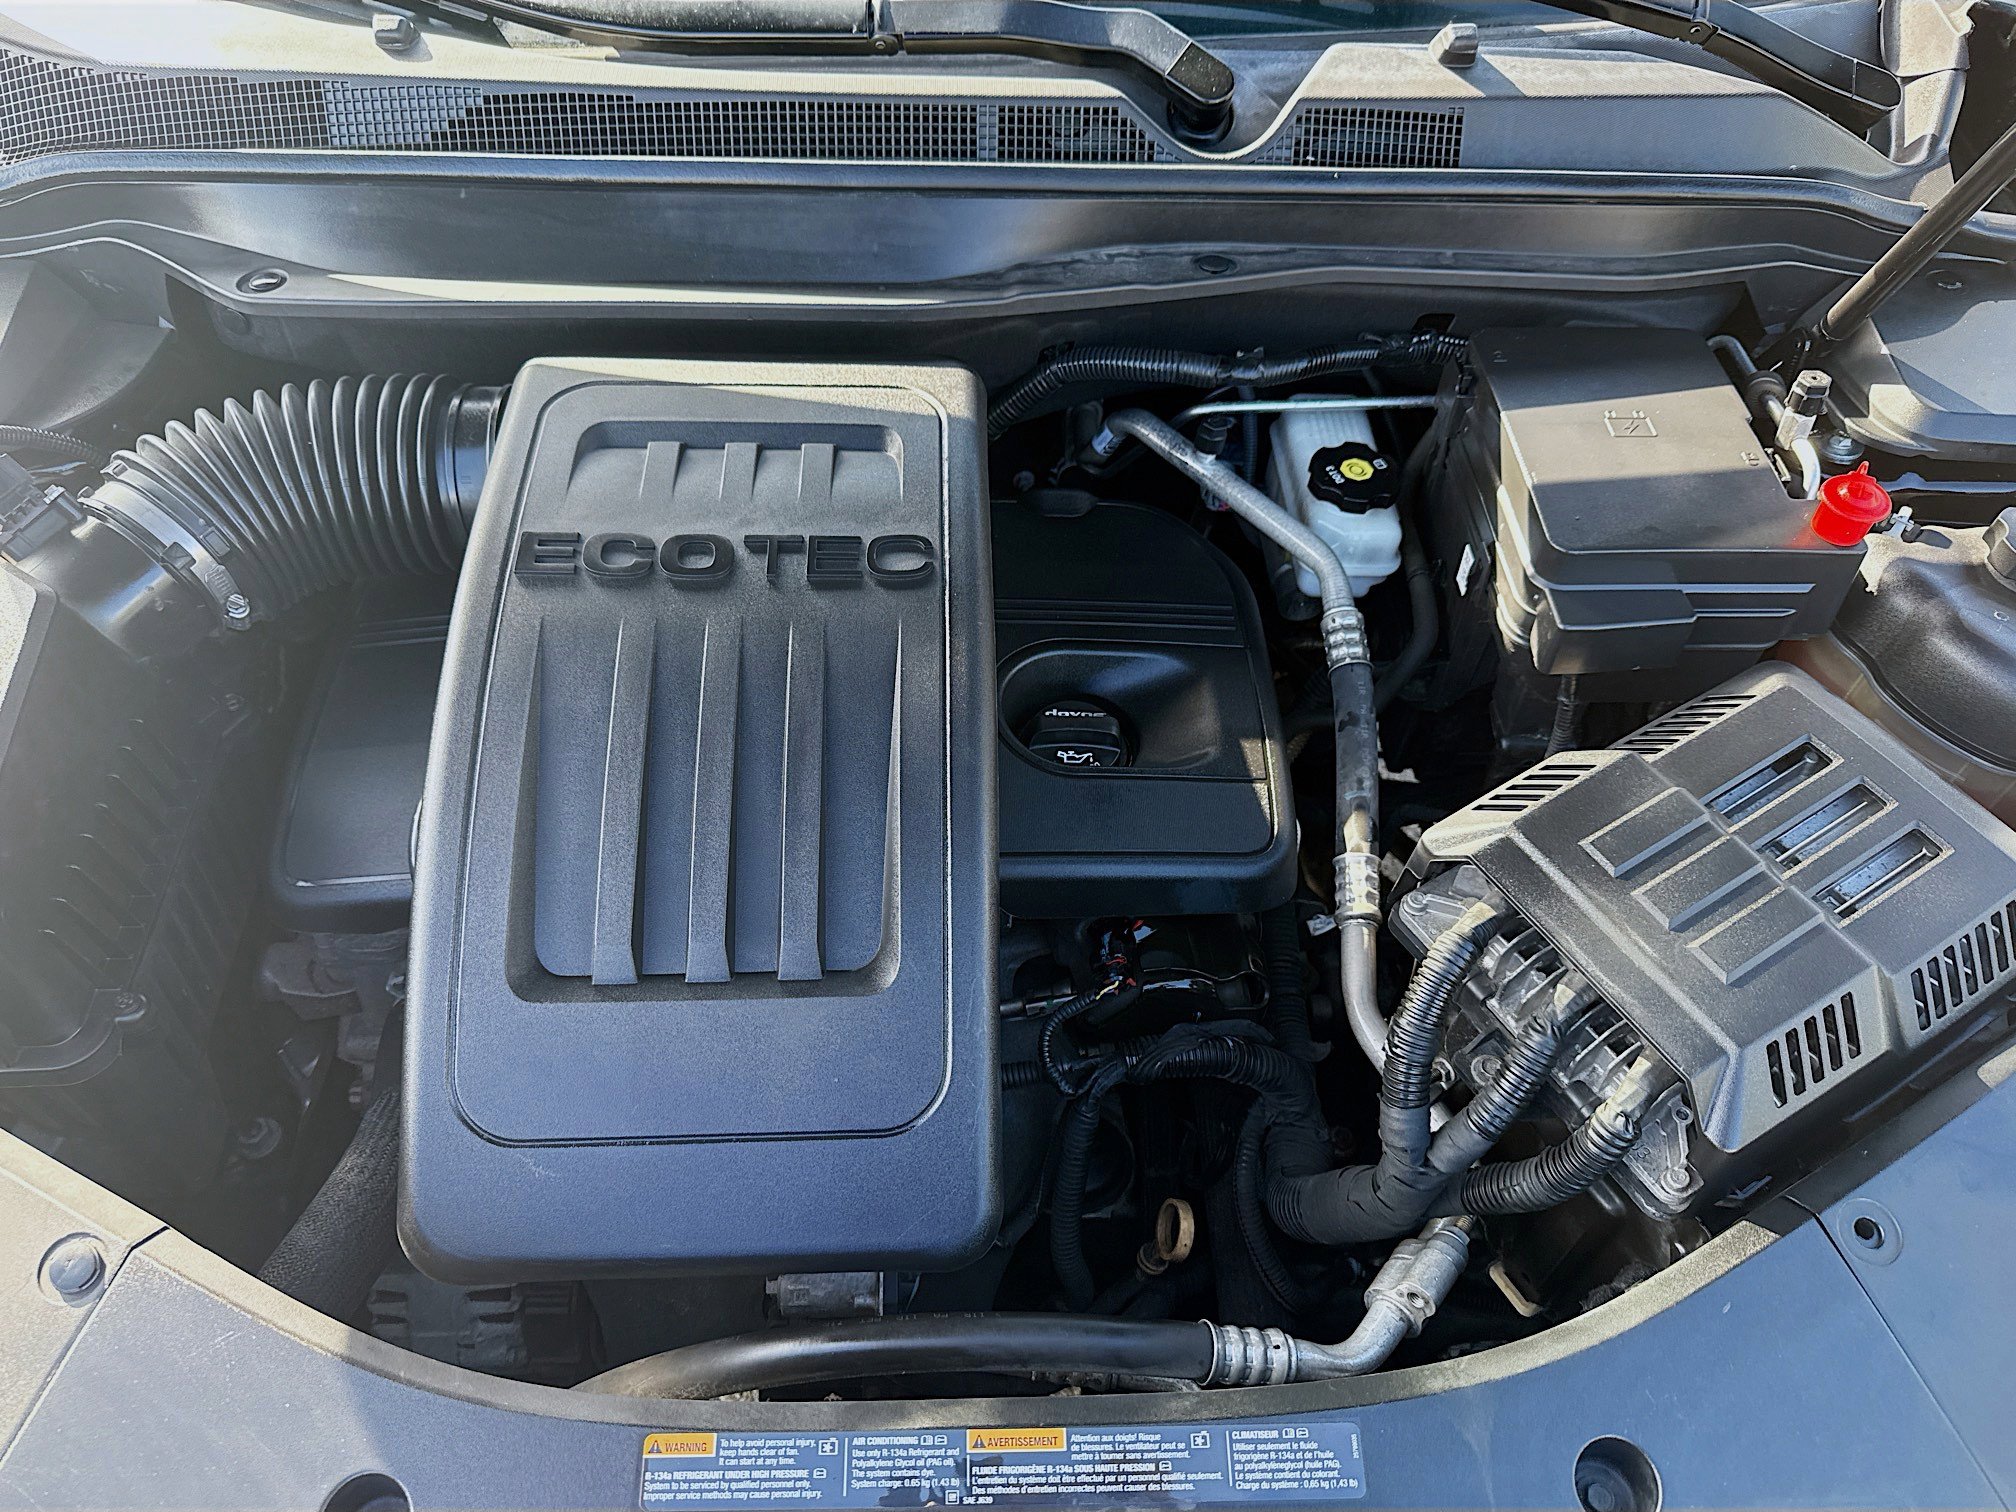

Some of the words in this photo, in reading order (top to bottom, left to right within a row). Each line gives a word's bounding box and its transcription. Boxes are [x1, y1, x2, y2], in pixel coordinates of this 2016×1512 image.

[514, 531, 935, 580] ECOTEC
[1071, 1434, 1100, 1442] Attention
[1139, 1433, 1161, 1441] Risque
[1232, 1430, 1279, 1439] CLIMATISEUR
[720, 1439, 729, 1447] To
[730, 1439, 744, 1448] help
[747, 1439, 764, 1447] avoid
[766, 1439, 794, 1448] personal
[867, 1437, 918, 1445] CONDITIONING
[988, 1436, 1058, 1447] AVERTISSEMENT
[1162, 1442, 1176, 1450] peut
[1233, 1442, 1255, 1450] Utiliser
[1257, 1442, 1290, 1450] seulement
[1300, 1441, 1318, 1449] fluide
[666, 1443, 706, 1452] WARNING
[867, 1449, 880, 1458] only
[909, 1448, 945, 1457] Refrigerant
[1233, 1452, 1268, 1462] frigorigène
[1270, 1451, 1294, 1460] R-134a
[852, 1459, 893, 1468] Polyalkylene
[895, 1458, 915, 1467] Glycol
[916, 1458, 924, 1466] oil
[926, 1458, 942, 1466] (PAG
[943, 1458, 956, 1466] oil).
[1305, 1460, 1322, 1470] (huile
[1324, 1460, 1341, 1469] PAG).
[866, 1470, 890, 1478] system
[921, 1469, 935, 1477] dye.
[972, 1466, 998, 1474] FLUIDE
[999, 1464, 1046, 1474] FRIGORIGÈNE
[1047, 1465, 1073, 1473] R-134a
[1096, 1464, 1118, 1472] HAUTE
[1120, 1463, 1155, 1472] PRESSION
[645, 1472, 672, 1480] R-134a
[673, 1471, 724, 1479] REFRIGERANT
[725, 1470, 750, 1479] UNDER
[752, 1470, 770, 1478] HIGH
[771, 1470, 809, 1478] PRESSURE
[1008, 1476, 1017, 1484] du
[1019, 1476, 1046, 1485] système
[1048, 1475, 1060, 1483] doit
[1062, 1475, 1075, 1483] être
[1077, 1474, 1103, 1482] effectué
[1128, 1473, 1160, 1482] personnel
[1162, 1472, 1185, 1481] qualifié
[1187, 1472, 1223, 1480] seulement.
[1245, 1471, 1272, 1480] système
[1274, 1471, 1300, 1479] contient
[644, 1482, 670, 1491] System
[690, 1481, 719, 1489] serviced
[721, 1481, 728, 1490] by
[730, 1481, 759, 1489] qualified
[761, 1480, 794, 1489] personnel
[796, 1480, 811, 1488] only.
[851, 1480, 875, 1488] System
[922, 1478, 930, 1488] kg
[932, 1478, 949, 1487] (1.43
[951, 1478, 959, 1487] lb)
[1236, 1481, 1259, 1491] Charge
[1261, 1481, 1270, 1489] du
[1271, 1480, 1298, 1491] système
[1321, 1479, 1329, 1489] kg
[1349, 1478, 1358, 1488] lb)
[987, 1486, 1019, 1494] méthodes
[1058, 1484, 1095, 1492] incorrectes
[1097, 1484, 1123, 1493] peuvent
[644, 1492, 674, 1501] Improper
[676, 1492, 701, 1500] service
[703, 1491, 732, 1499] methods
[733, 1492, 747, 1500] may
[772, 1491, 800, 1500] personal
[962, 1496, 976, 1504] SAE
